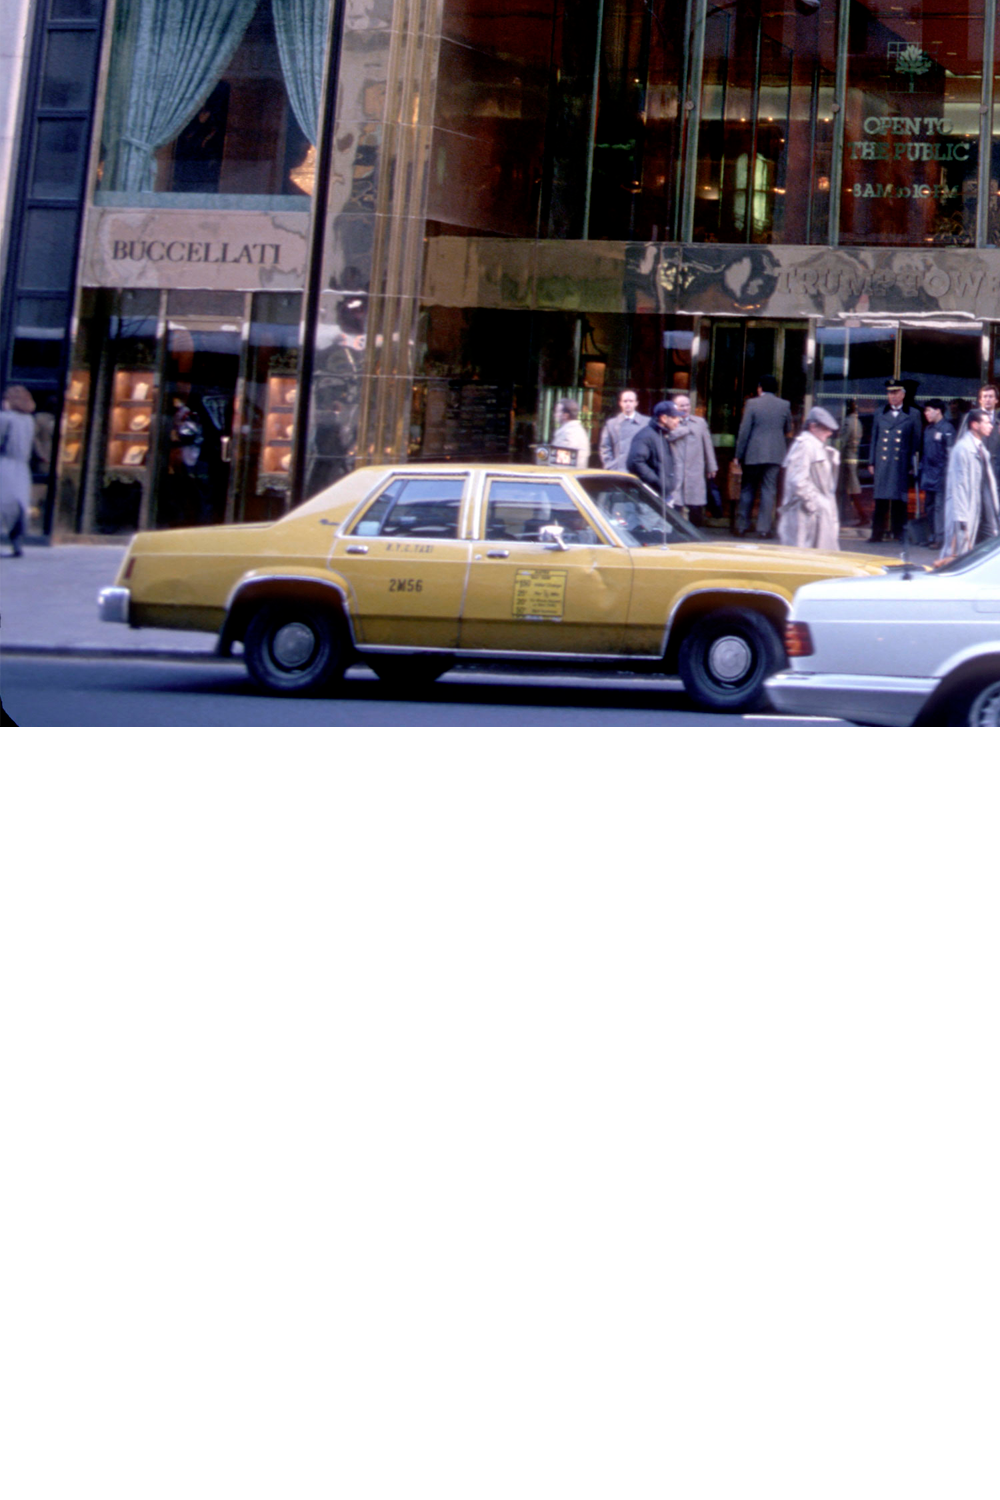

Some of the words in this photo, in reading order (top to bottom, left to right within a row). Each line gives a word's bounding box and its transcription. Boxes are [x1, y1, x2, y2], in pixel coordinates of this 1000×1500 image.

[863, 116, 922, 135] OPEN
[923, 117, 953, 135] TO
[848, 141, 889, 160] THE
[893, 141, 970, 161] PUBLIC
[112, 240, 282, 265] BUCCELLATI
[775, 267, 896, 297] TRUMP
